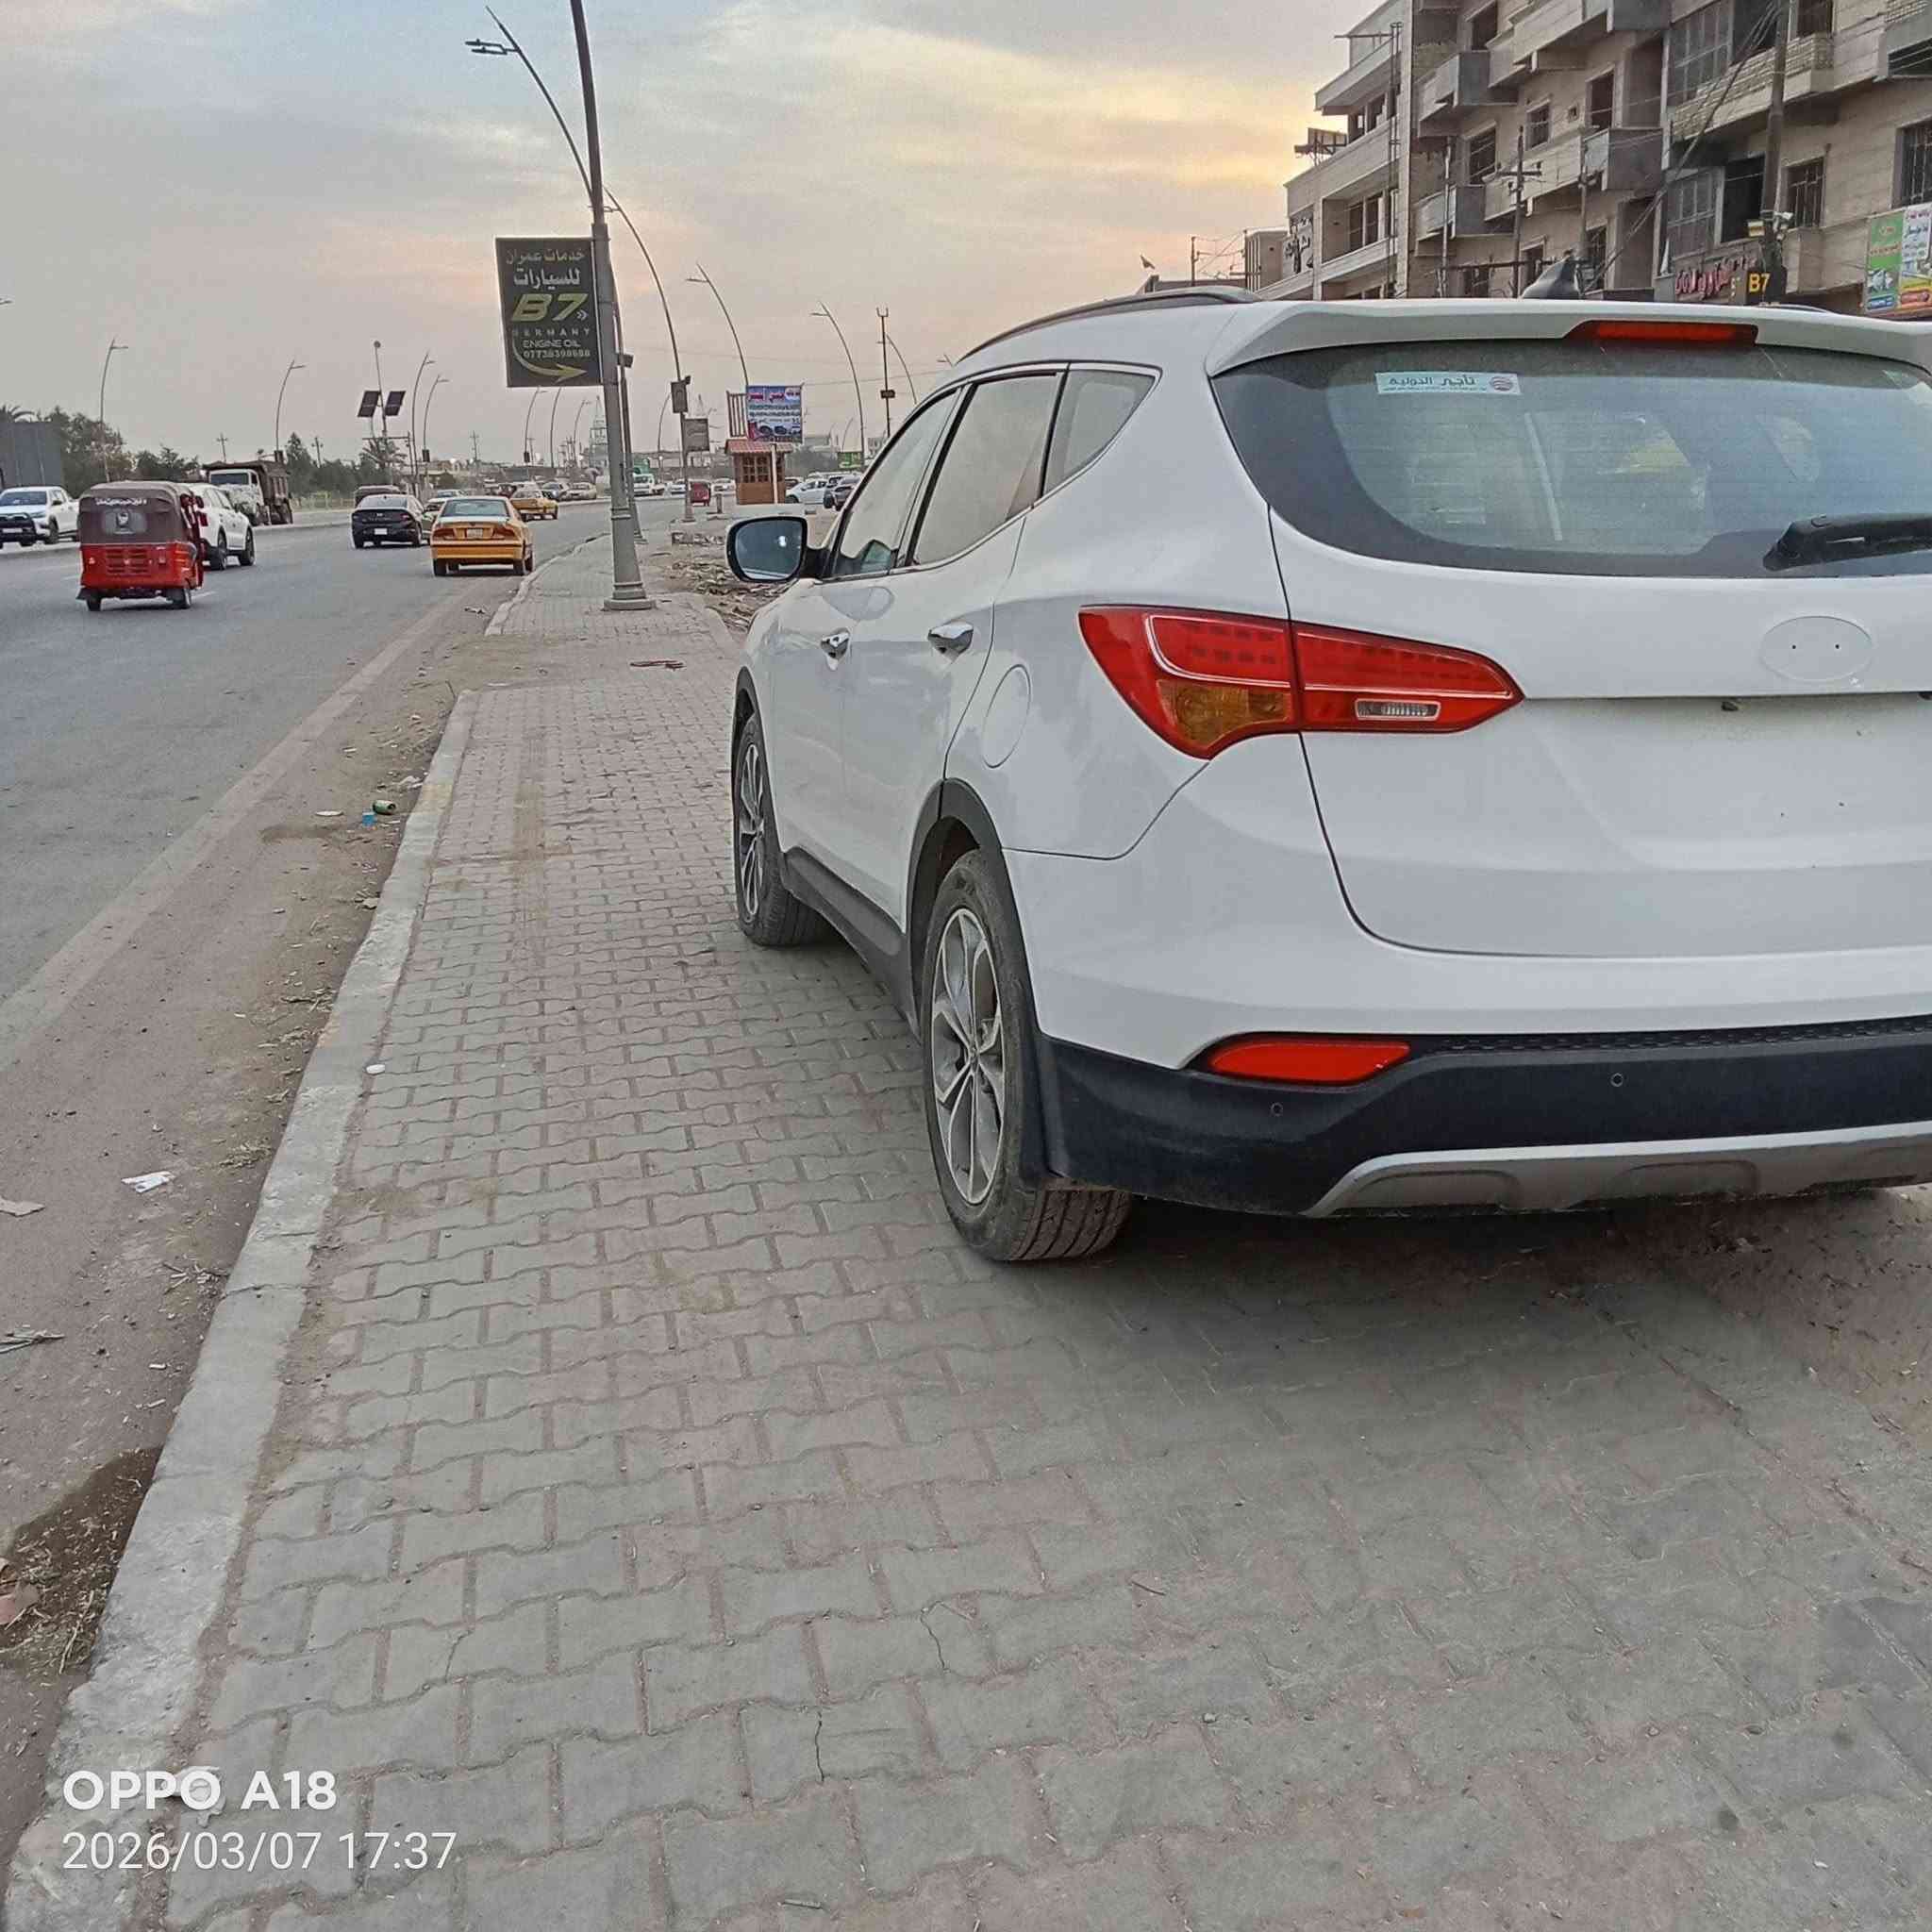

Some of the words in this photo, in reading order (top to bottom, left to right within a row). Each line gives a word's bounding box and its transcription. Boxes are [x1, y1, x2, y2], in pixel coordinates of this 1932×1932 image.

[543, 247, 585, 263] خدمات
[513, 268, 581, 291] للسيارات
[1748, 273, 1771, 293] B7
[511, 293, 589, 322] B7
